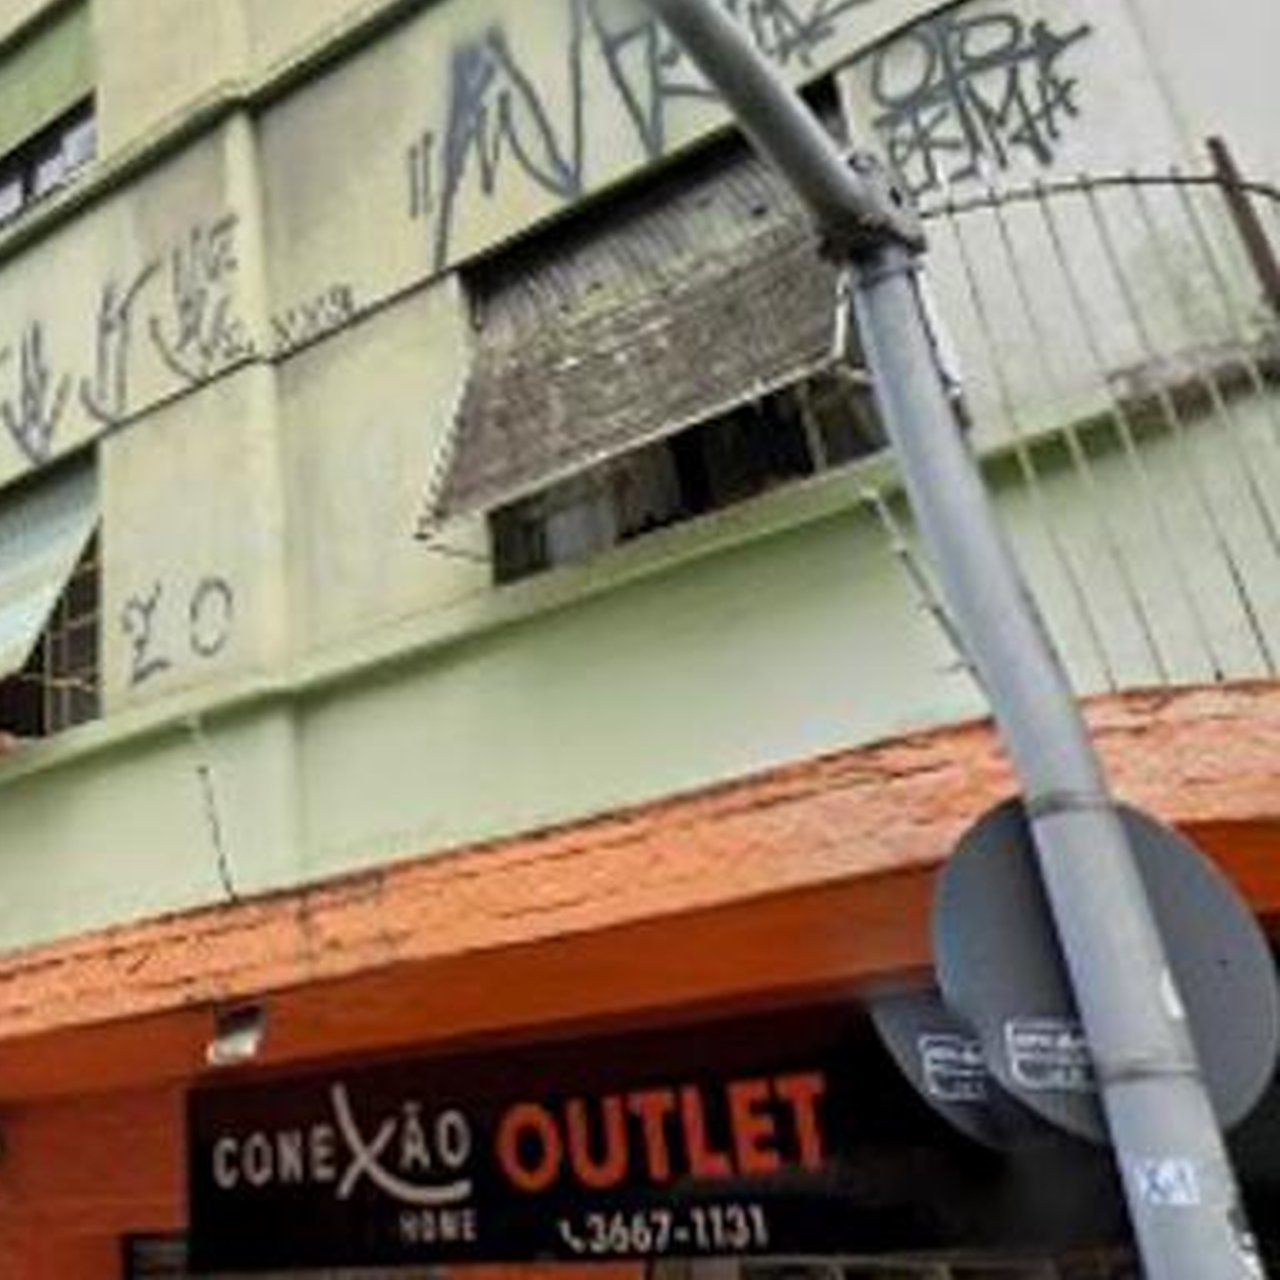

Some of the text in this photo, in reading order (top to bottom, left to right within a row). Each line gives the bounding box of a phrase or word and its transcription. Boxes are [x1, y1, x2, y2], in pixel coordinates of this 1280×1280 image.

[212, 1072, 826, 1205] CONEXÃO OUTLET
[586, 1204, 769, 1254] 3667-1131
